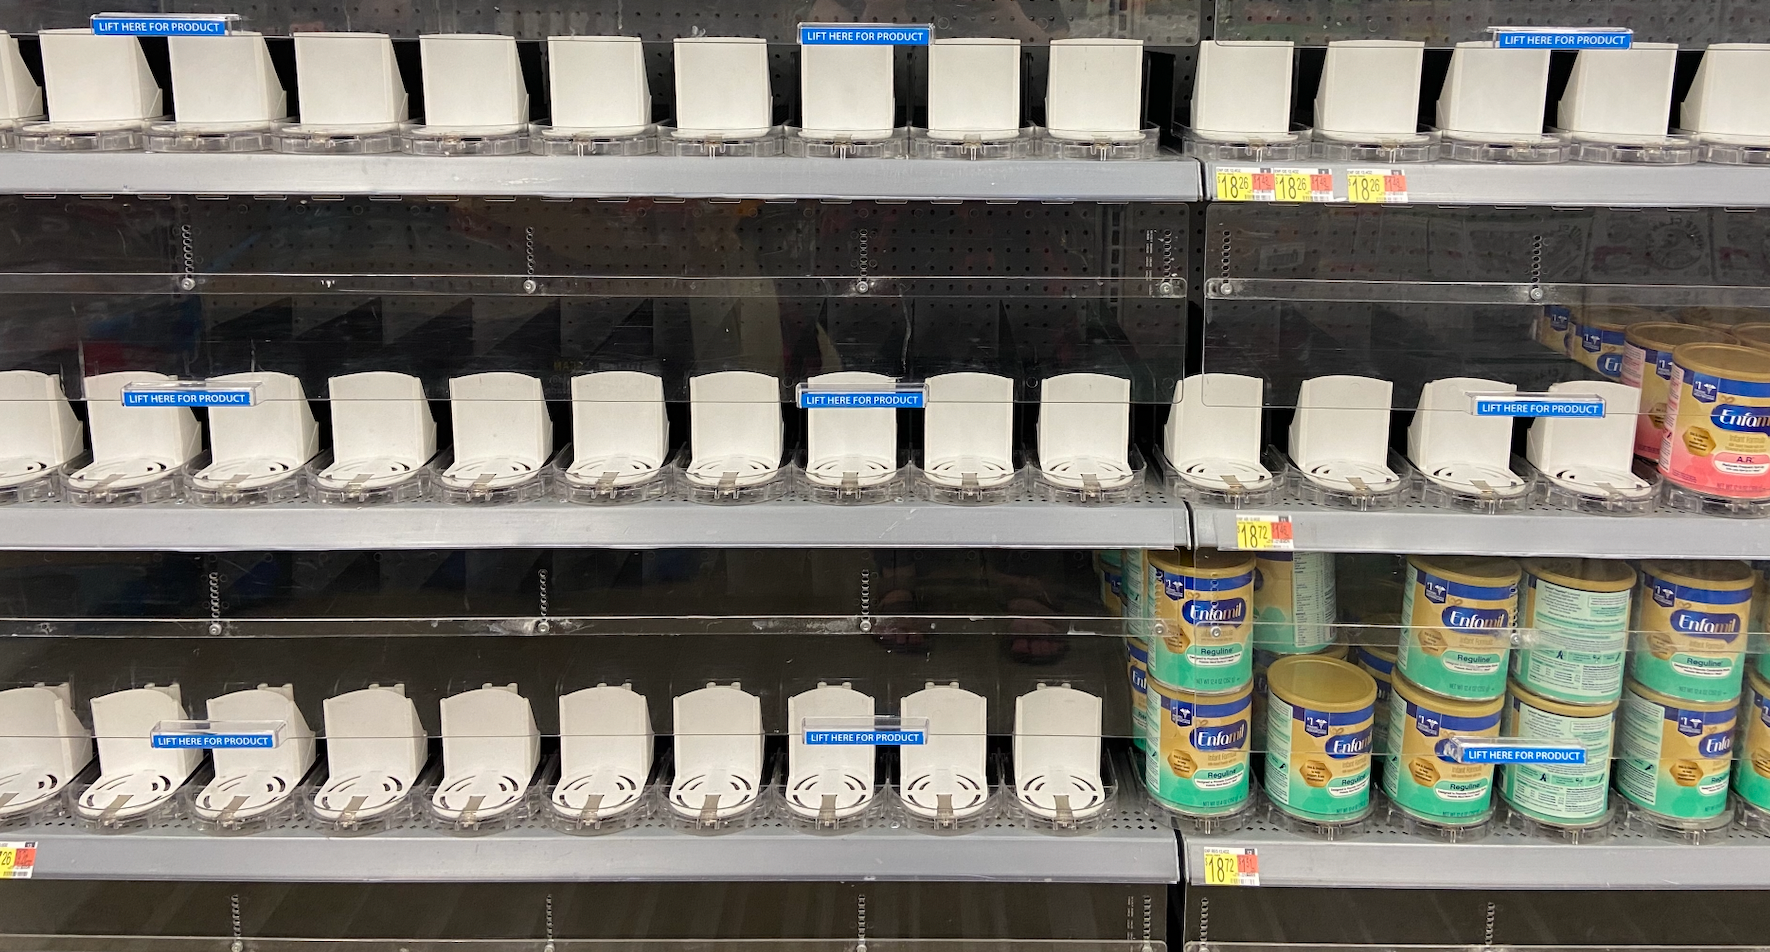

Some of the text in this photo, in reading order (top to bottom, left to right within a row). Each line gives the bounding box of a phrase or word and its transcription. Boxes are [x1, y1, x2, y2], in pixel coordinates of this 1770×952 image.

[100, 22, 220, 32] LIFT HERE FOR PRODUCT
[807, 32, 923, 41] LIFT HERE FOR PRODUCT
[1505, 36, 1625, 44] LIFT HERE FOR PRODUCT
[129, 394, 245, 403] LIFT HERE FOR PRODUCT
[807, 396, 918, 404] LIFT HERE FOR PRODUCT
[1482, 404, 1599, 413] LIFT HERE FOR PRODUCT
[1190, 602, 1242, 621] Enfamil
[1450, 611, 1504, 628] Enfamil
[1679, 614, 1736, 633] Enfamil
[1201, 648, 1232, 656] Reguline
[1457, 654, 1490, 663] Reguline
[1687, 658, 1722, 667] Reguline
[811, 733, 919, 742] LIFT HERE FOR PRODUCT
[1198, 723, 1245, 746] Enfamil
[158, 737, 268, 746] LIFT HERE FOR PRODUCT
[1468, 751, 1580, 760] LIFT HERE FOR PRODUCT
[1207, 768, 1236, 779] Reguline
[1450, 783, 1480, 791] Reguline
